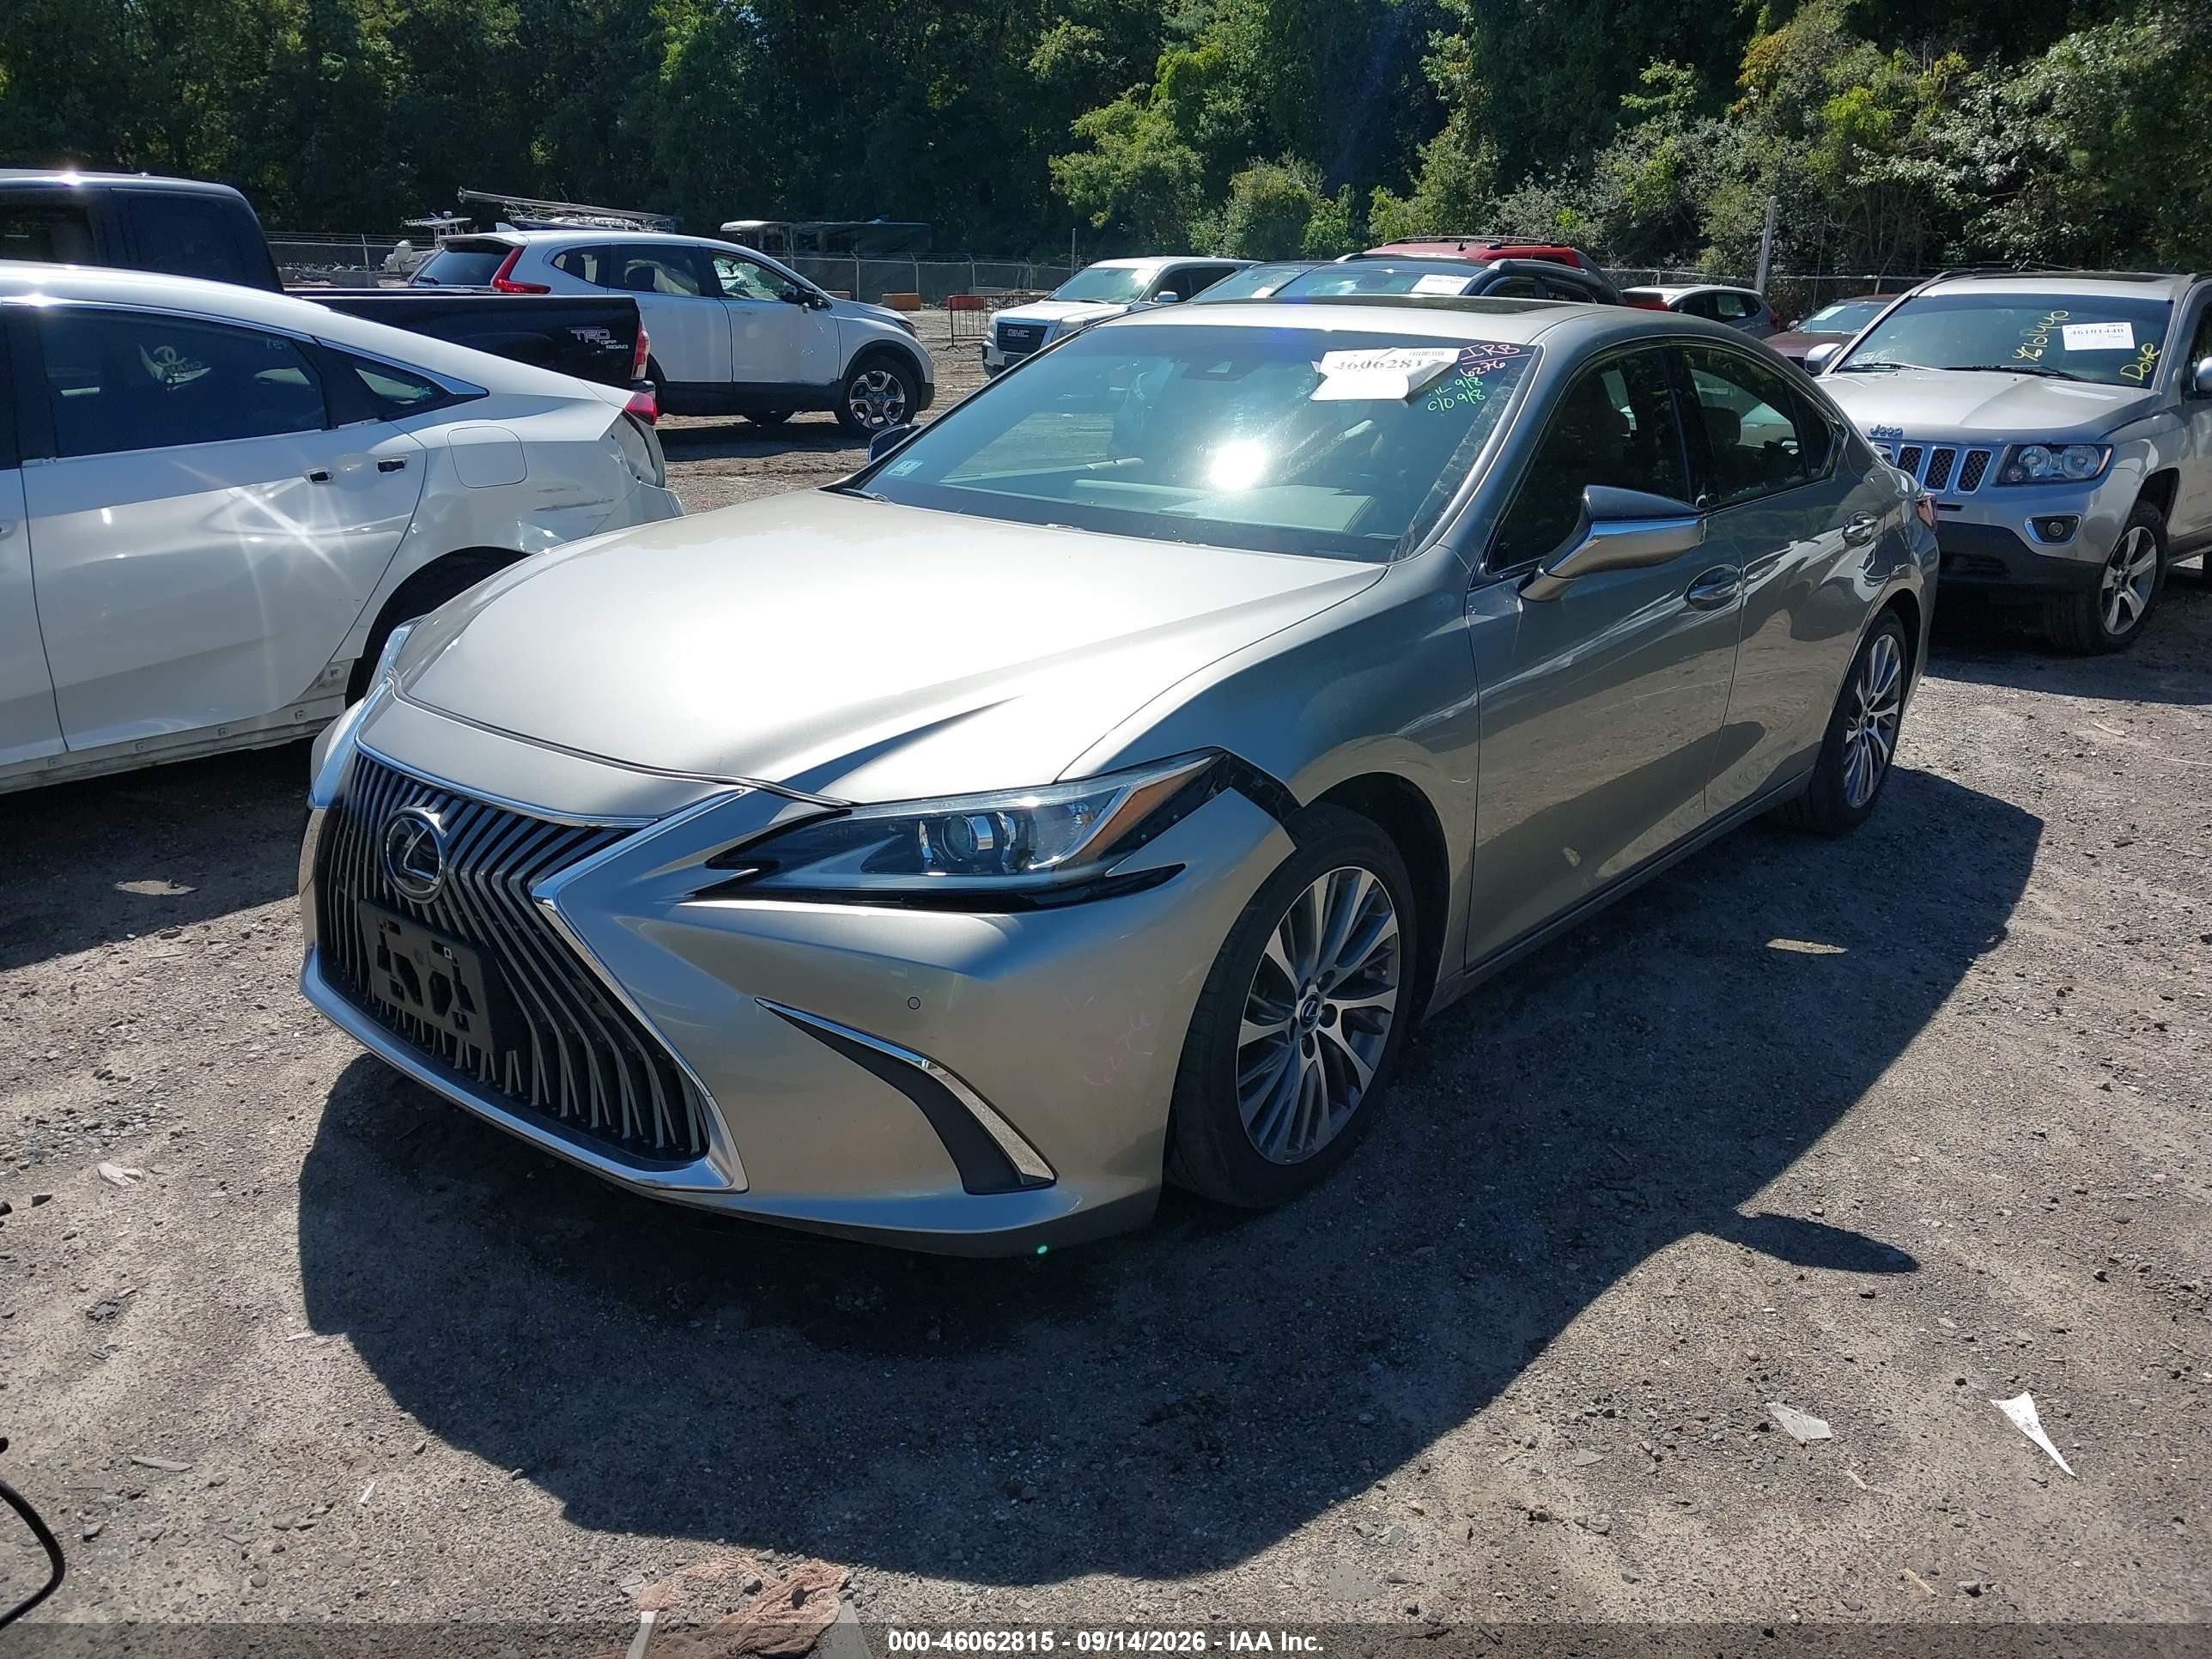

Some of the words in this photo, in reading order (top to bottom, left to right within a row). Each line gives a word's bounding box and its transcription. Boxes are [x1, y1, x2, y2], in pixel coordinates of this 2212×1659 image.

[570, 328, 611, 343] TRD
[1007, 328, 1030, 338] GMC
[1334, 358, 1439, 370] 4606281
[1459, 360, 1506, 377] 6276
[1869, 424, 1904, 438] Jeep
